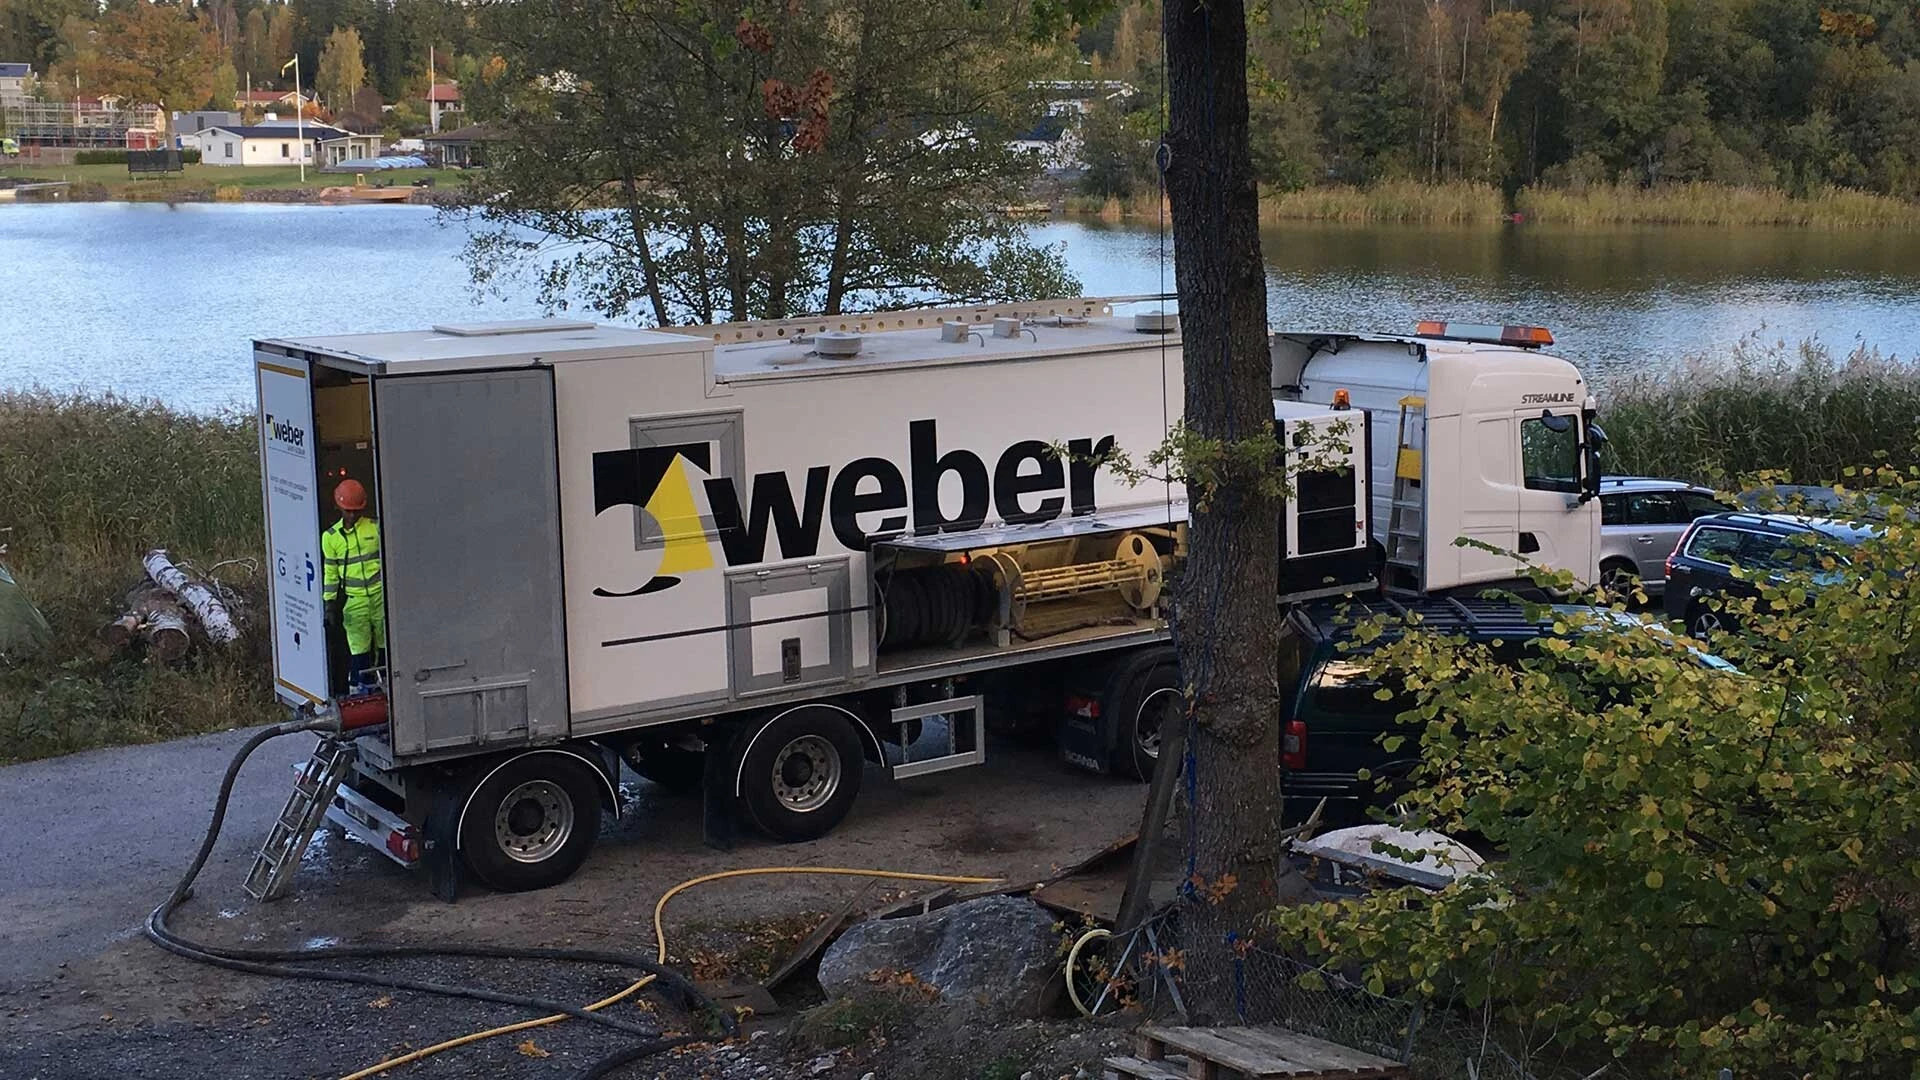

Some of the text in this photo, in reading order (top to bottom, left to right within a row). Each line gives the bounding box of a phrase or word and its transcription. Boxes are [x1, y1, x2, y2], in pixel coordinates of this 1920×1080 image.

[1521, 393, 1575, 404] STREAMLINE
[273, 418, 305, 447] weber
[703, 418, 1116, 567] weber
